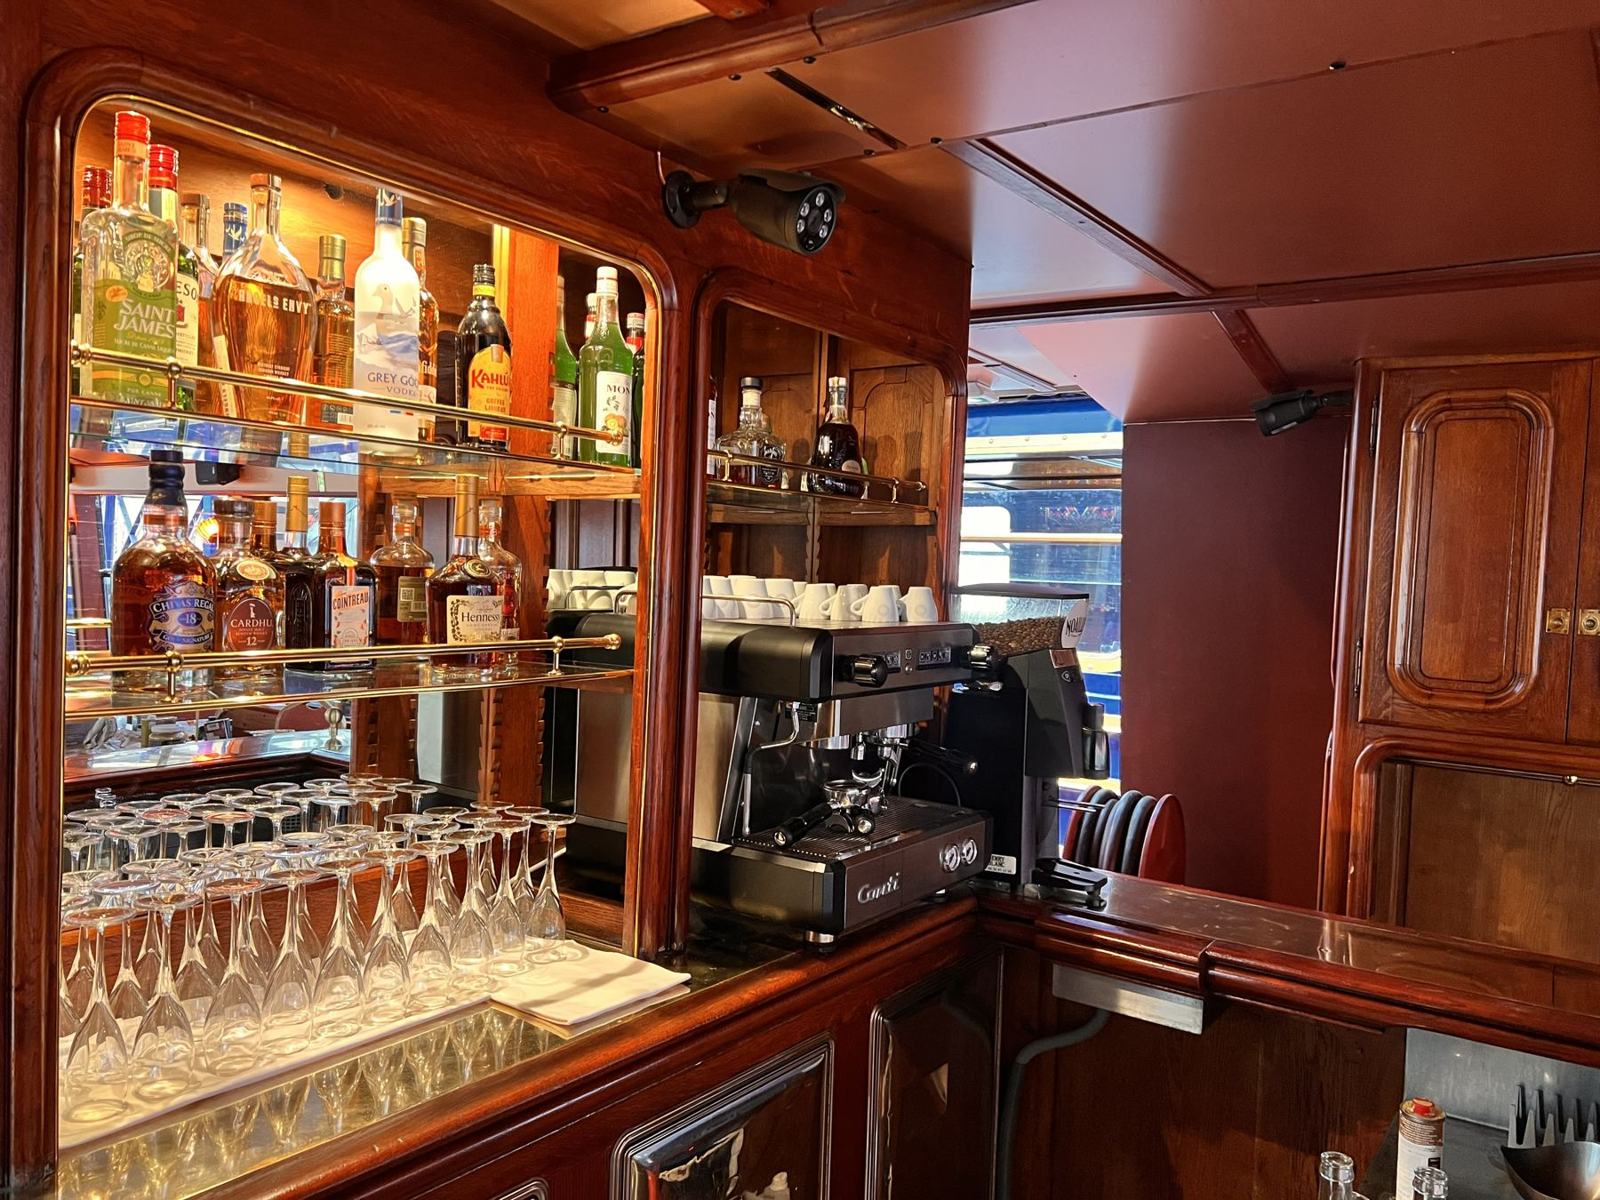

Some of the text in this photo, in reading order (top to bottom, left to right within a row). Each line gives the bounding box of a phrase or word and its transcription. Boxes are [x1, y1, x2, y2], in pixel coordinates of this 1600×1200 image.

[119, 297, 175, 323] SAINT
[282, 297, 311, 315] ENVY
[113, 314, 176, 340] JAMES
[367, 371, 398, 384] GREY
[152, 598, 192, 613] CHIVAS
[332, 591, 369, 610] COINTREAU
[185, 613, 197, 625] 18
[230, 619, 273, 628] CARDHU
[246, 636, 257, 646] 12
